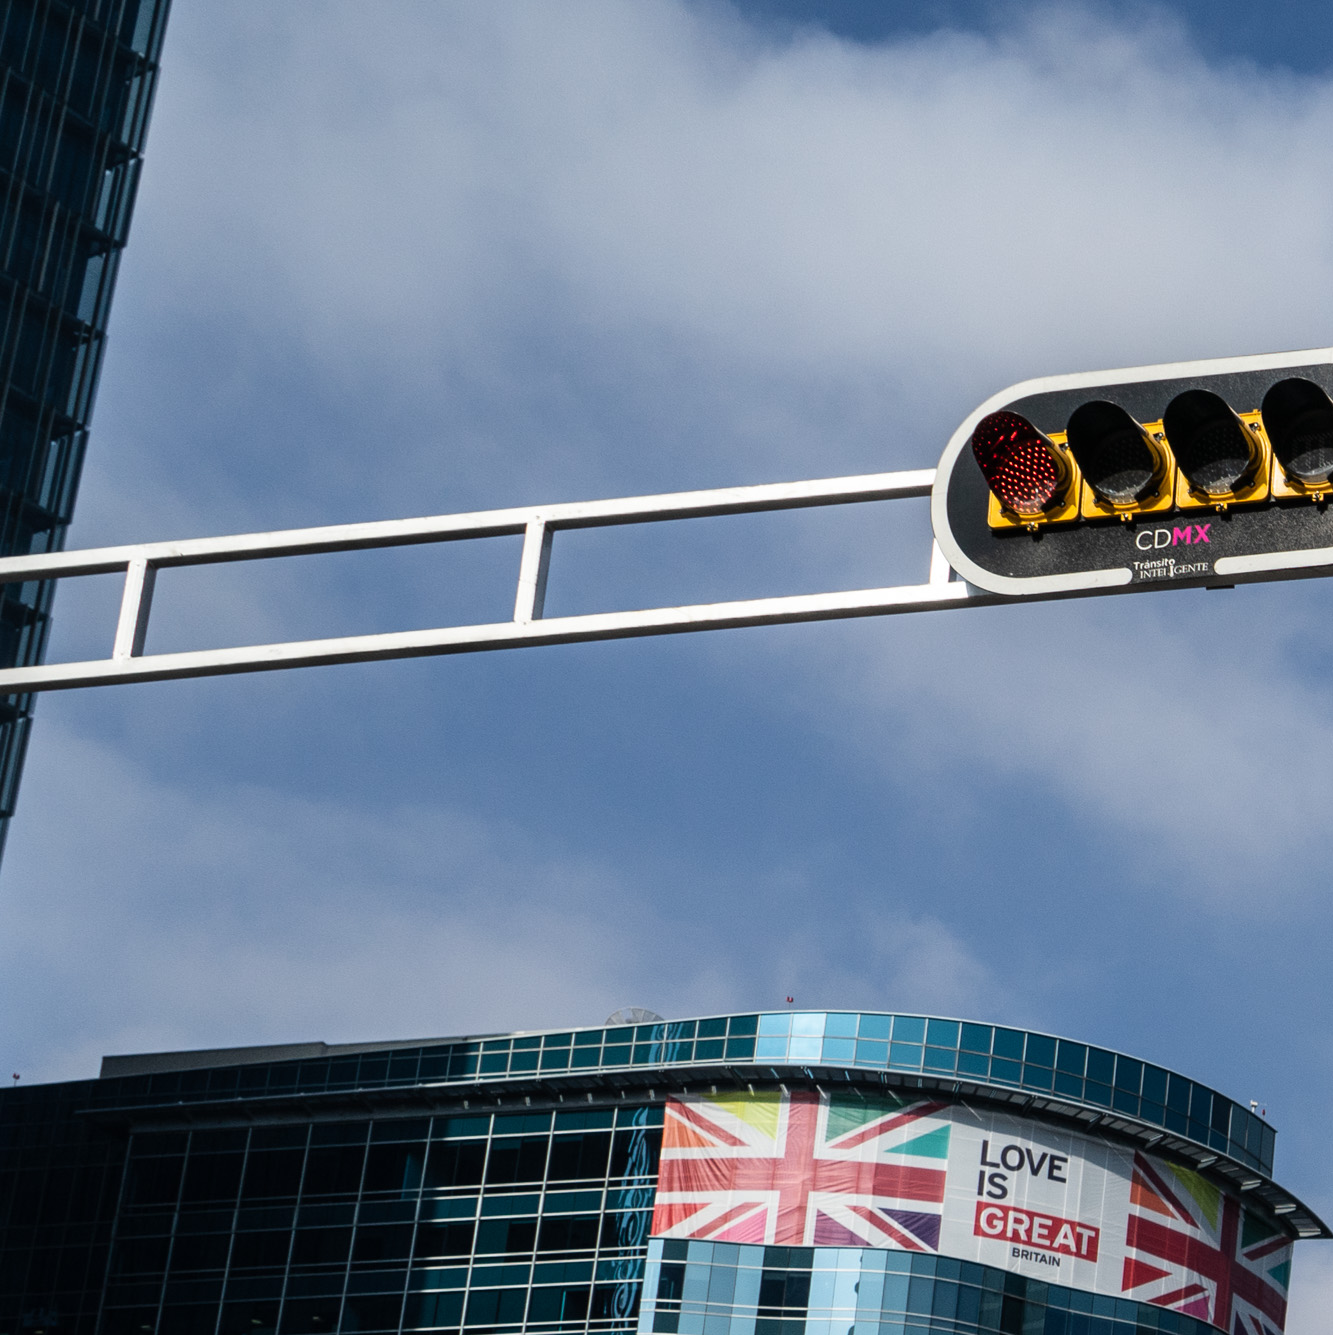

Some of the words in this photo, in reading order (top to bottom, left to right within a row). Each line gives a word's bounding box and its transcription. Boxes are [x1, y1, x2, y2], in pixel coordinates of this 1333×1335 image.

[1136, 524, 1211, 551] CDMX
[1133, 558, 1176, 571] Tránsito
[980, 1139, 1068, 1184] LOVE
[977, 1170, 1008, 1200] IS
[980, 1206, 1096, 1256] GREAT
[1012, 1247, 1061, 1267] BRITAIN
